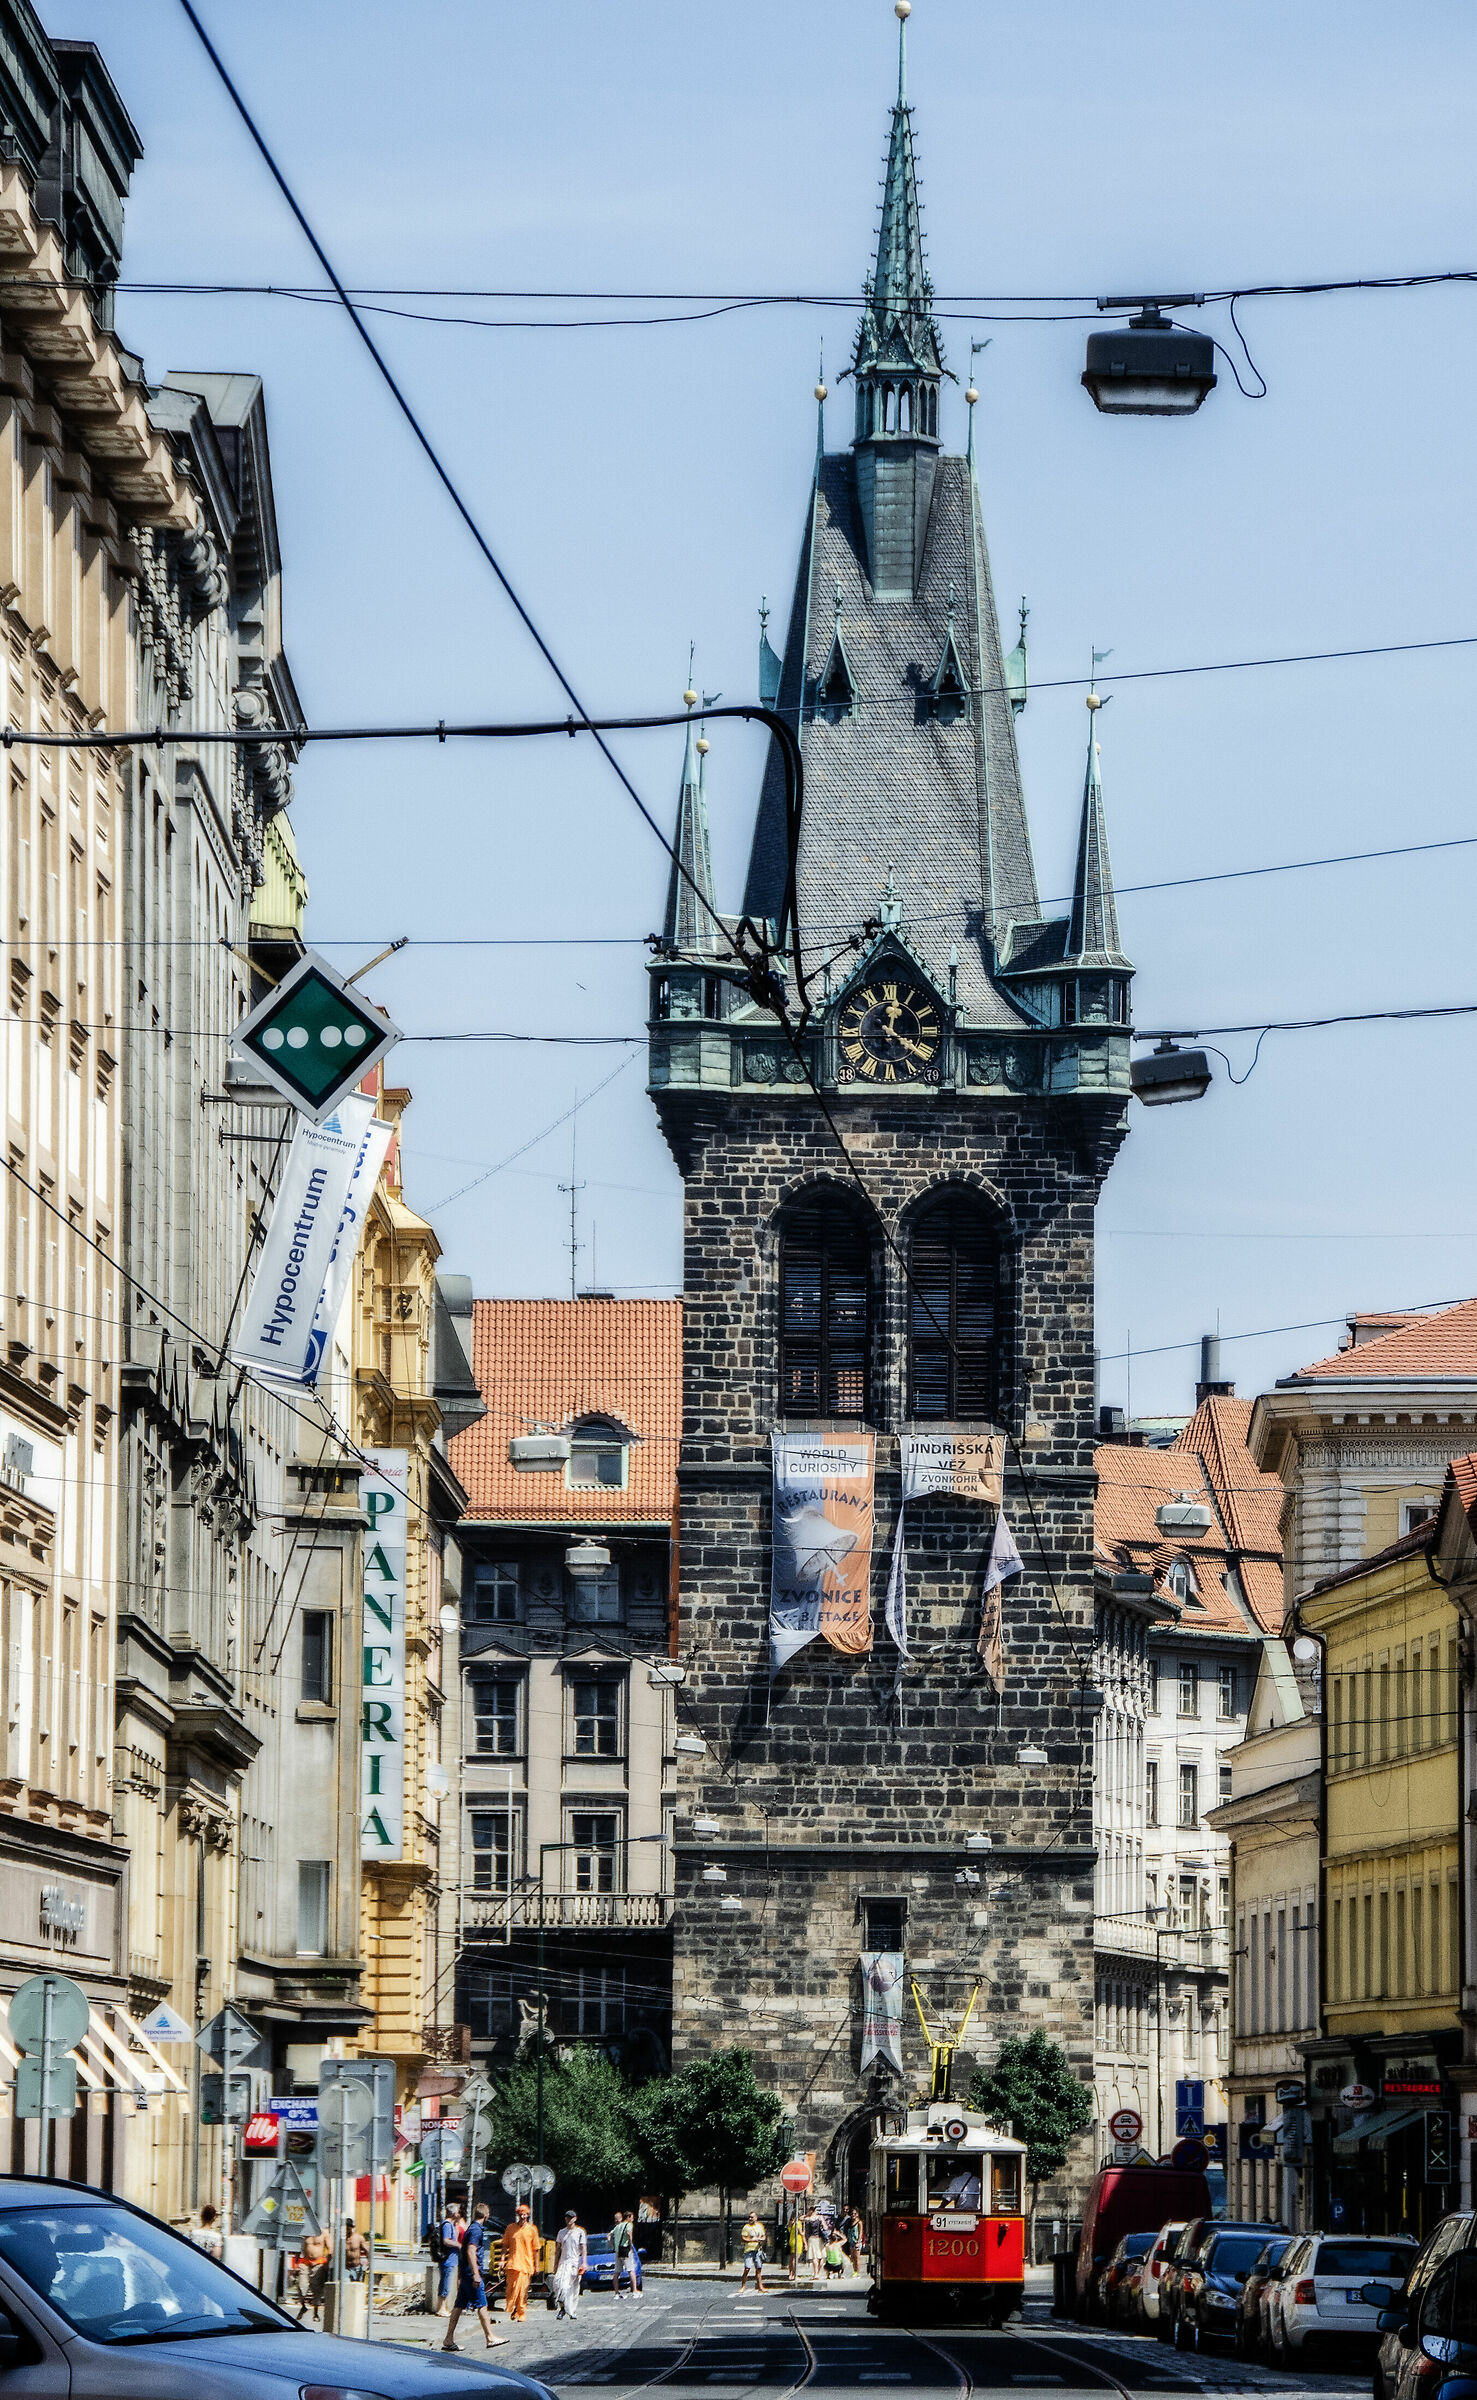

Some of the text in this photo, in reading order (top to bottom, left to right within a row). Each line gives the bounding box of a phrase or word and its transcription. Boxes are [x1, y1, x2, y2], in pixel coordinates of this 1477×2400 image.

[882, 985, 898, 1001] XII
[847, 1005, 865, 1020] X
[926, 1068, 938, 1082] 79
[302, 1128, 357, 1149] Hypocentrum
[260, 1167, 328, 1346] Hypocentrum
[800, 1449, 847, 1459] WORLD
[908, 1441, 995, 1455] JINDŘIŠSKÁ
[789, 1462, 857, 1472] CURIOSITY
[777, 1488, 869, 1513] RESTAURANT
[780, 1589, 862, 1604] ZVONICE
[817, 1611, 859, 1622] ETAGE
[361, 1491, 398, 1846] PANERIA
[1384, 2083, 1440, 2093] RESTAURACE
[288, 2110, 311, 2119] 0%
[246, 2117, 278, 2144] illy
[936, 2217, 947, 2228] 91
[928, 2239, 979, 2256] 1200
